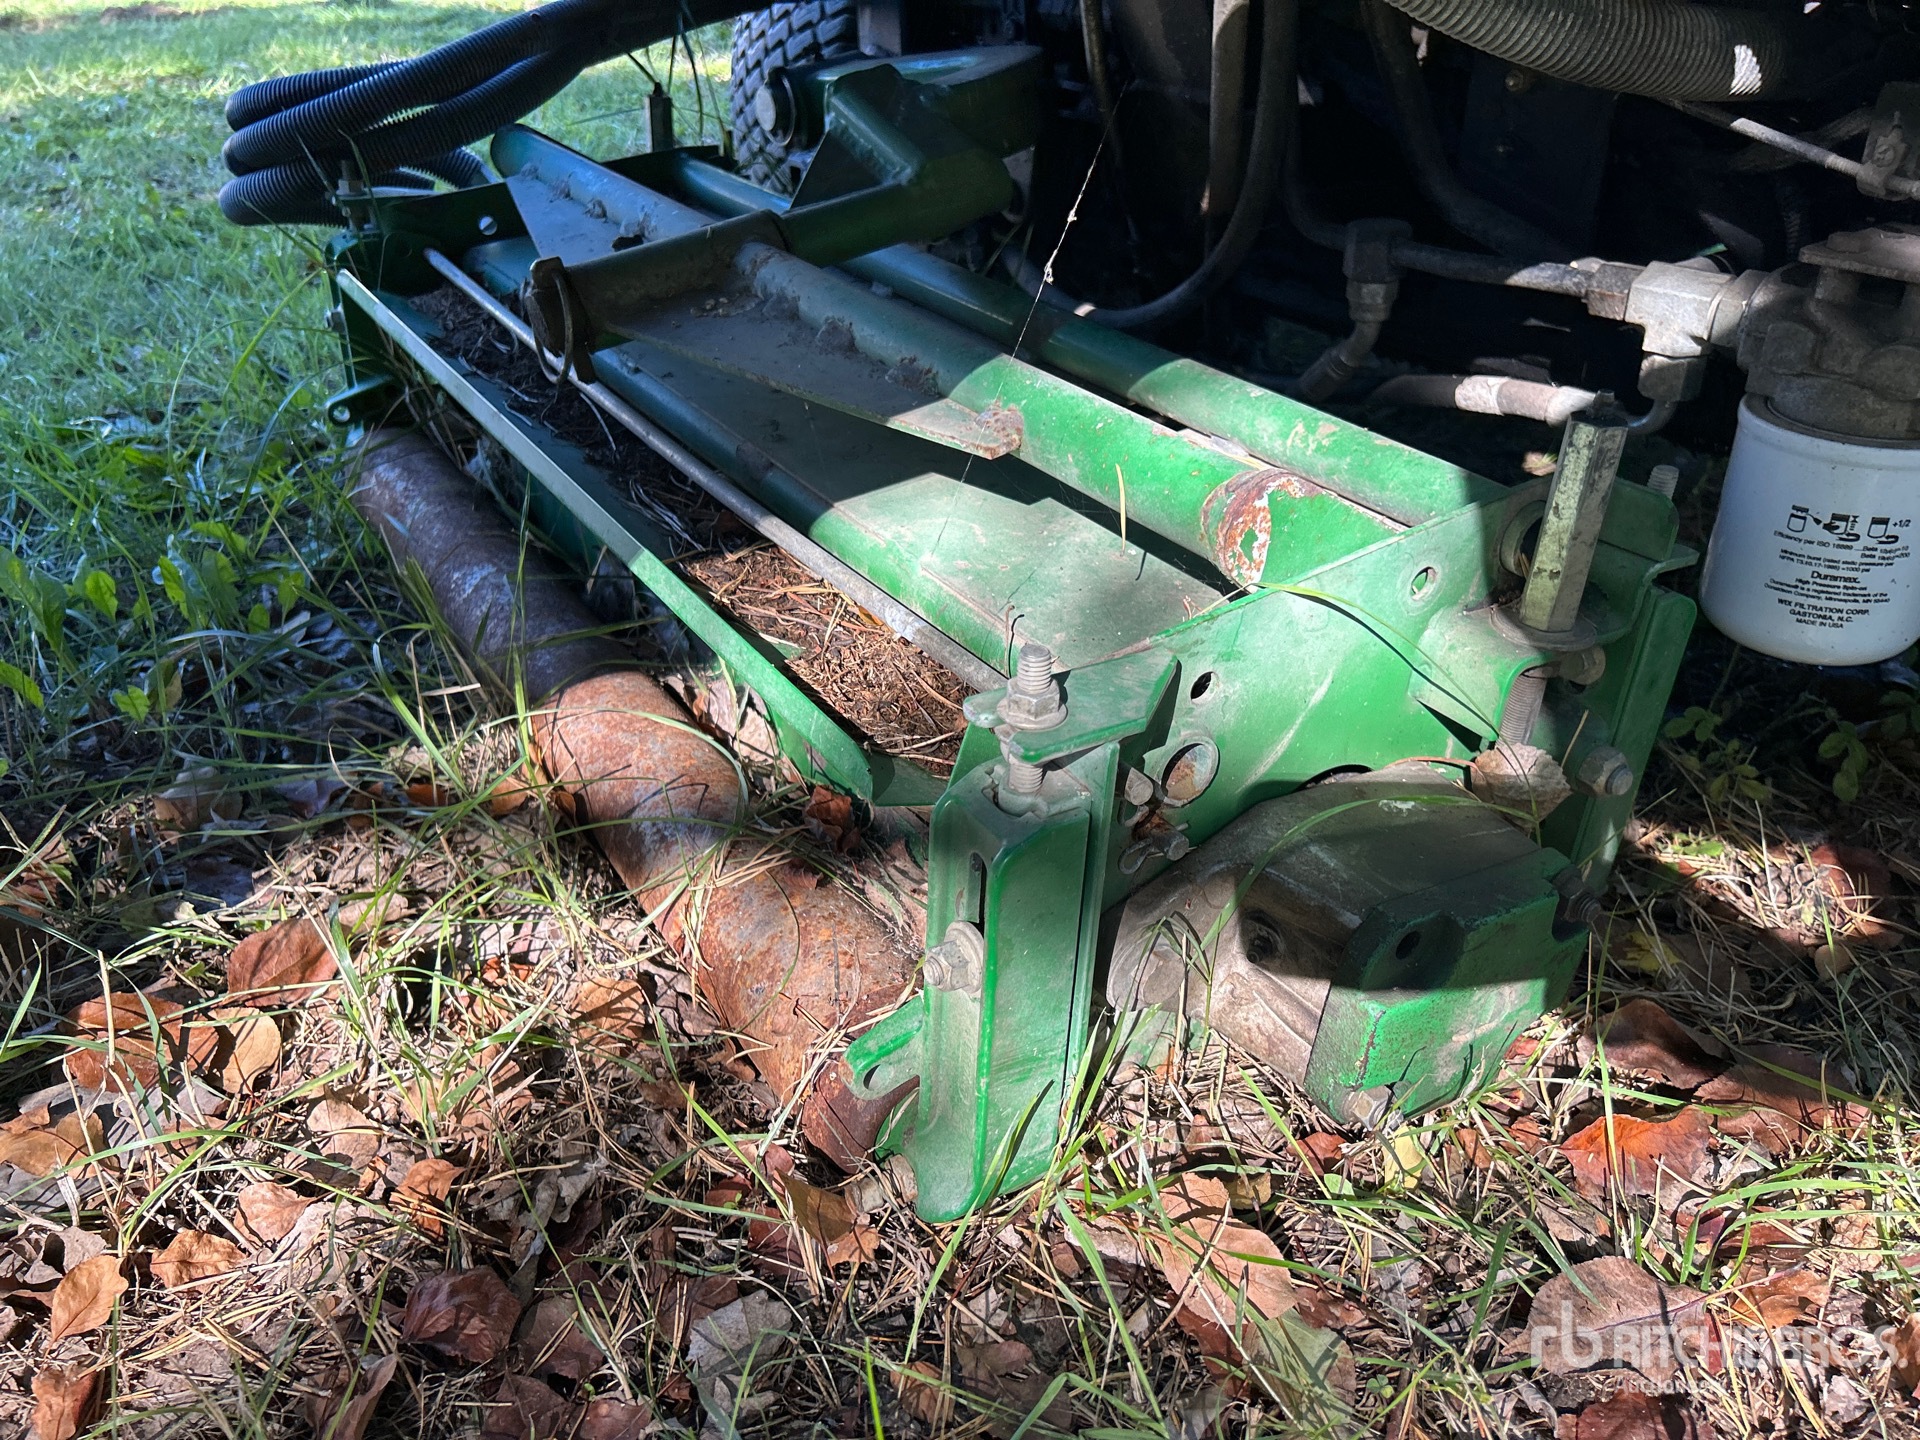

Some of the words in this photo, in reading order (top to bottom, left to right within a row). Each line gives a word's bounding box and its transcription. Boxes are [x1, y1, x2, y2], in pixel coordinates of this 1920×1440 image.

[1892, 519, 1911, 528] +1/2
[1774, 530, 1802, 543] Efficiency
[1817, 540, 1830, 548] ISO
[1795, 578, 1811, 586] High
[1812, 581, 1841, 589] Pressure
[1777, 597, 1793, 607] WIX
[1794, 601, 1845, 615] FILTRATION
[1795, 617, 1818, 627] MADE
[1828, 621, 1844, 629] USA
